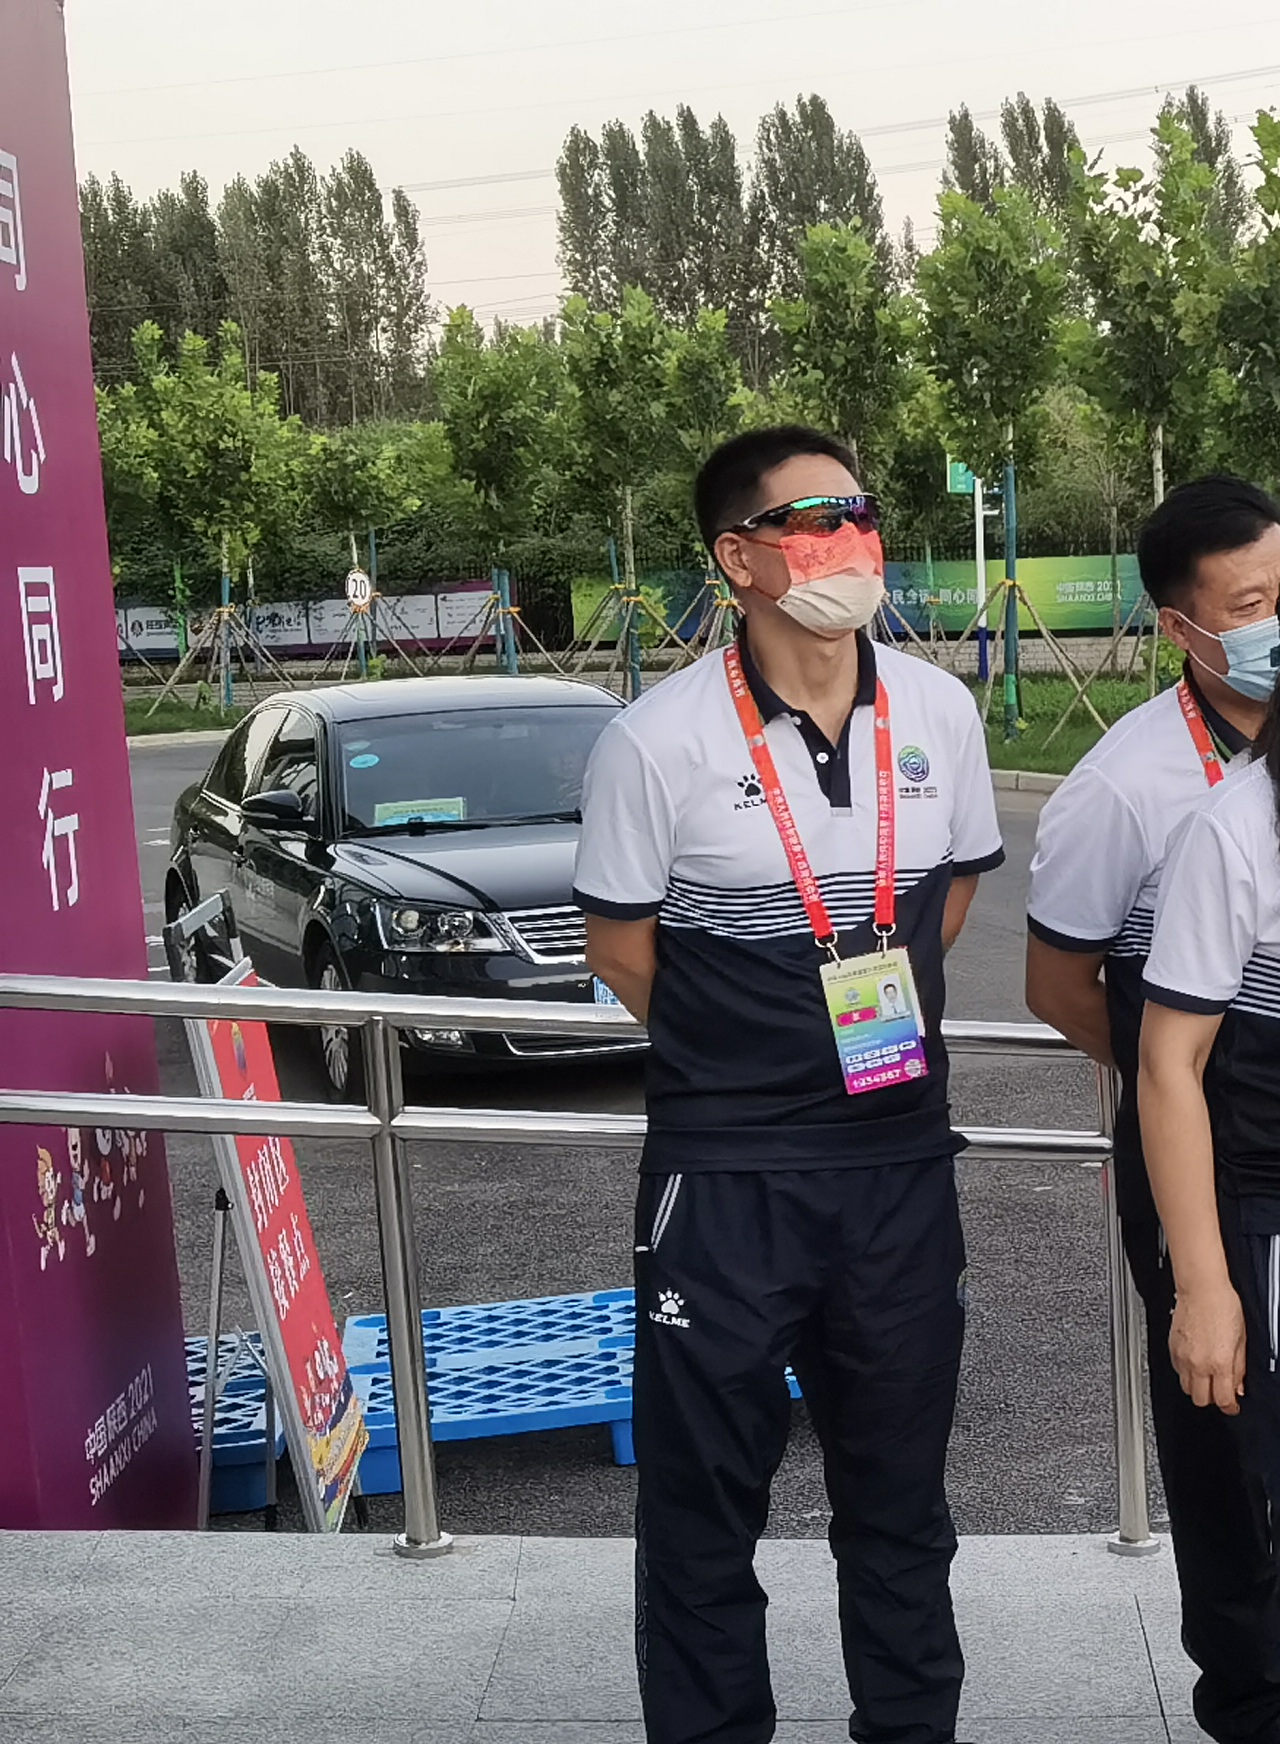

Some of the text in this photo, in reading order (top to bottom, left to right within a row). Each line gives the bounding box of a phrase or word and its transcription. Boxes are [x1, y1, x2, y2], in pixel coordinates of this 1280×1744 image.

[352, 579, 367, 599] 20
[940, 588, 980, 605] 同心同
[853, 1068, 902, 1089] 1234567
[649, 1310, 690, 1329] KELME
[128, 1363, 154, 1420] 2021
[89, 1406, 158, 1506] SHAANXI CHINA
